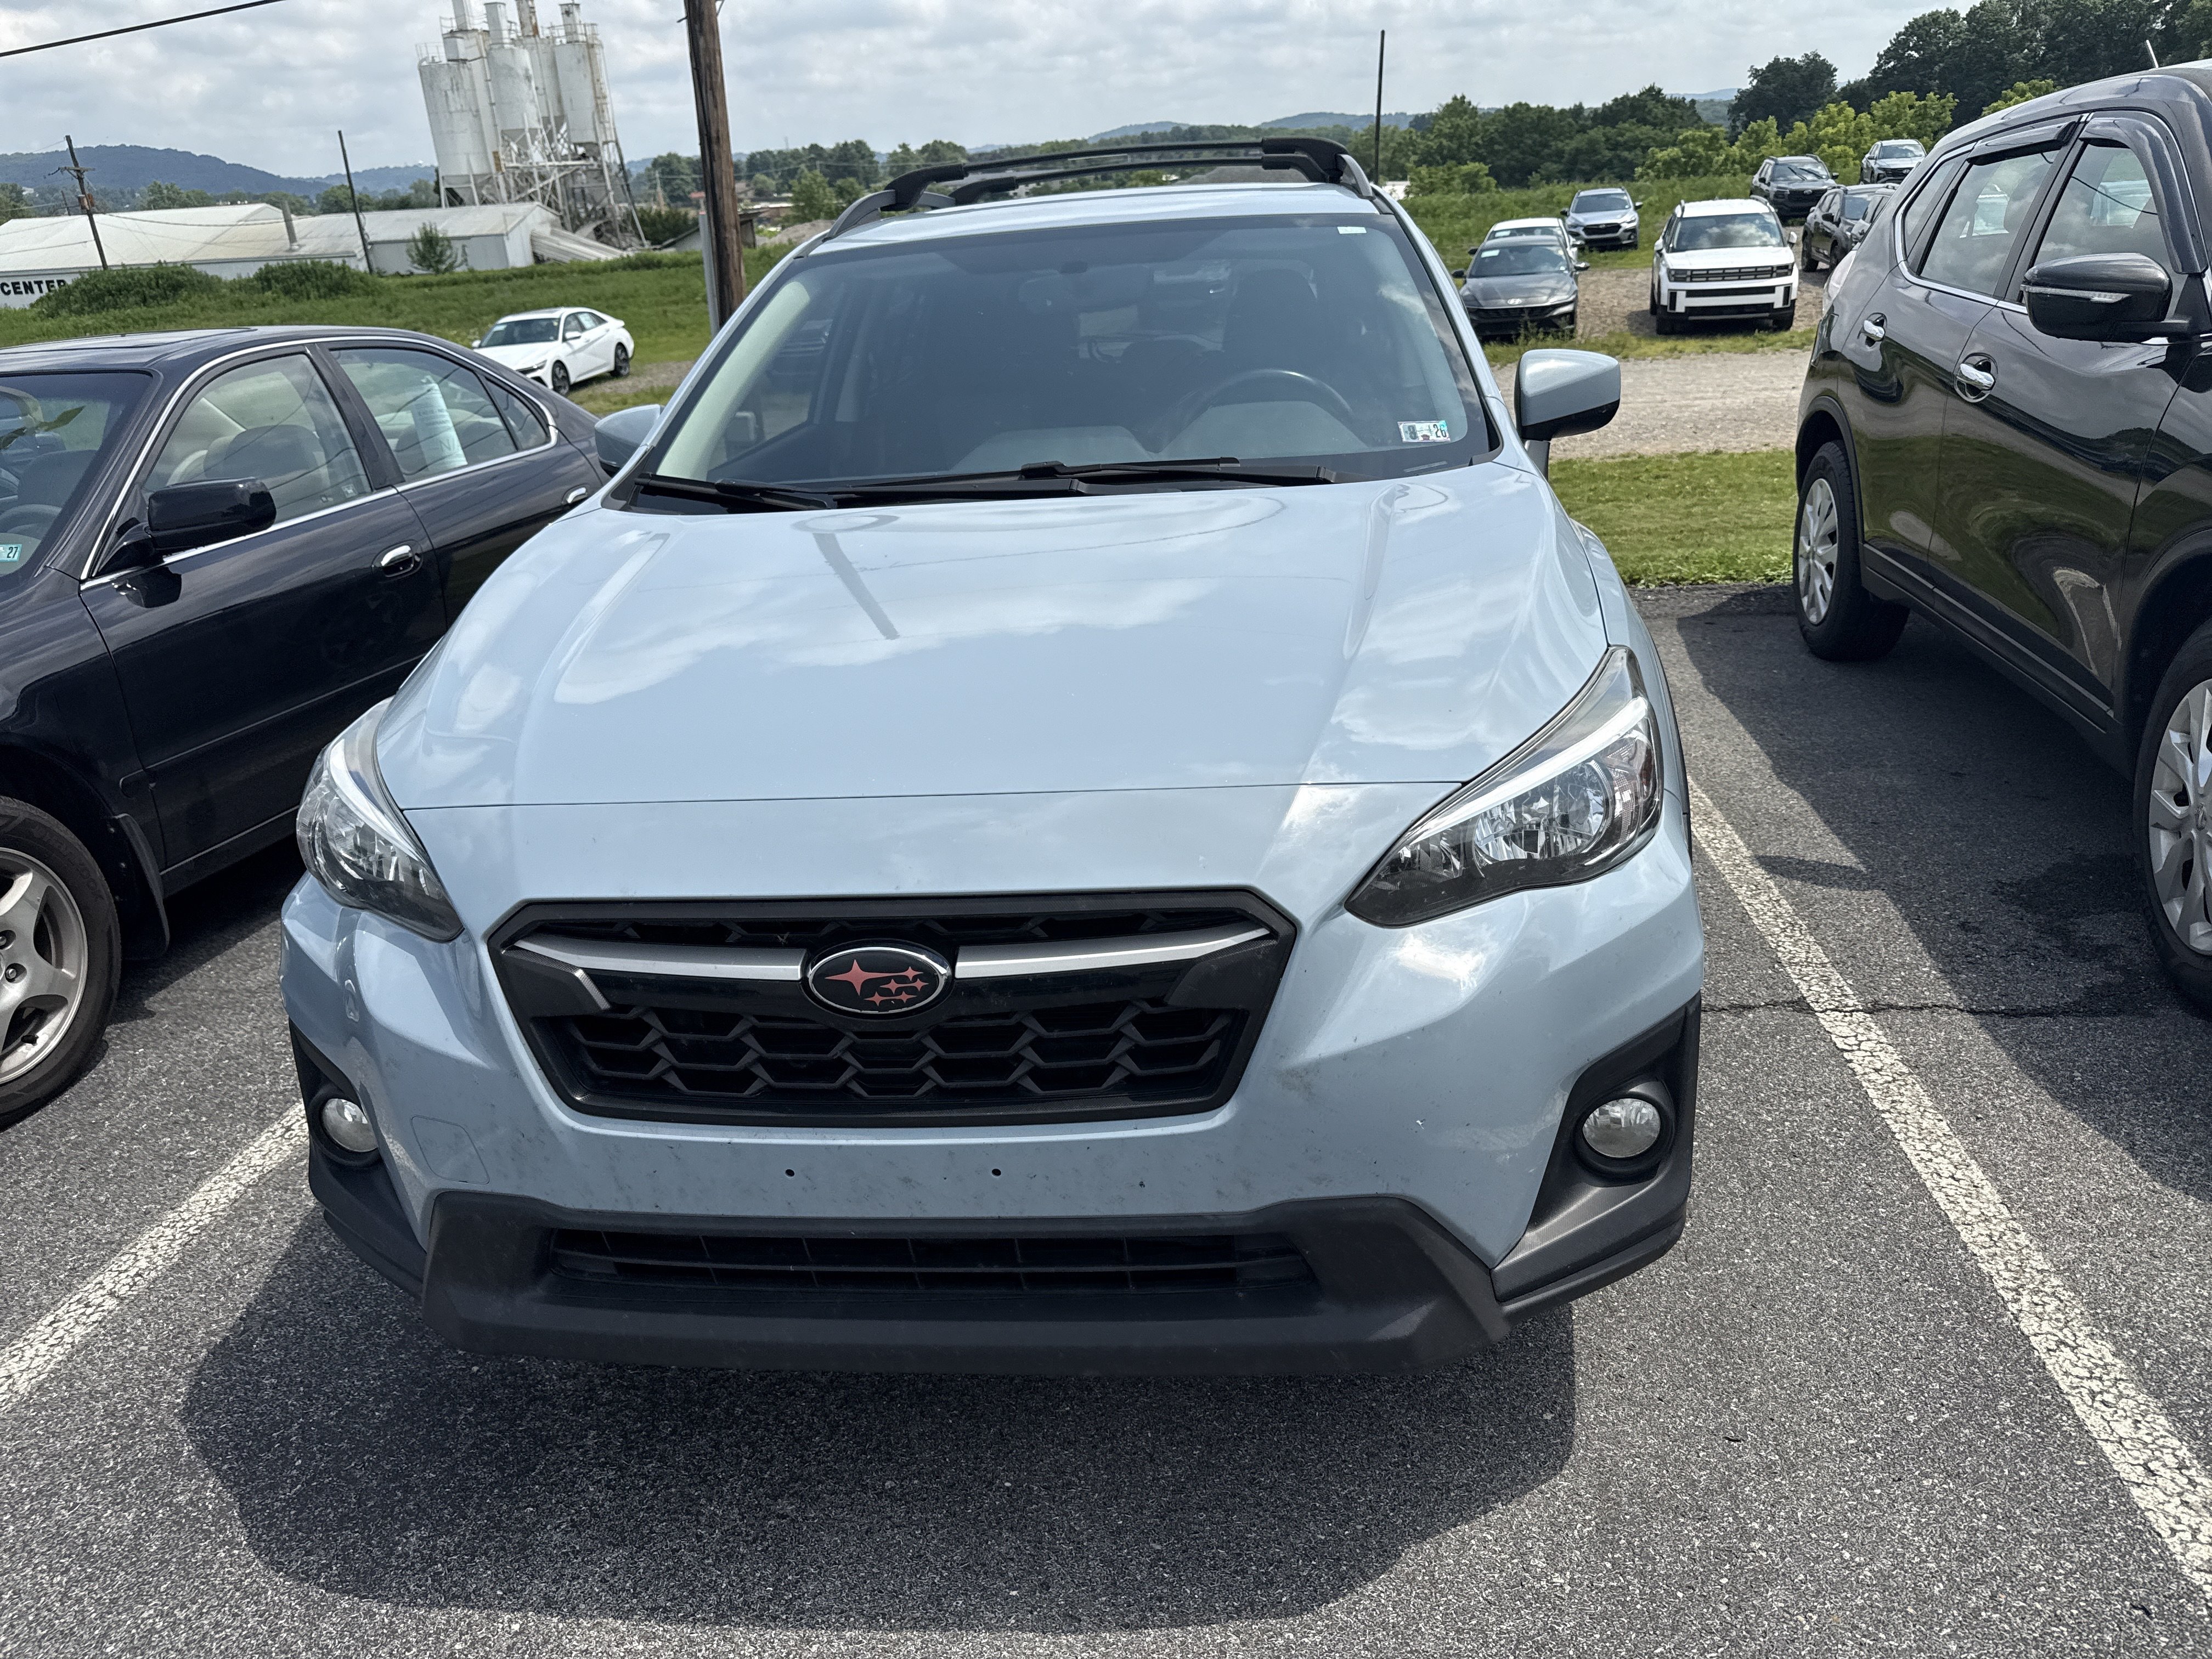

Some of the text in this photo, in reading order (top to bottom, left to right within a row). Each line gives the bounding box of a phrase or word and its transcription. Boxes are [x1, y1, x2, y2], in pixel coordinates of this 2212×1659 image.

[1407, 424, 1447, 440] 8 26
[7, 546, 19, 558] 27
